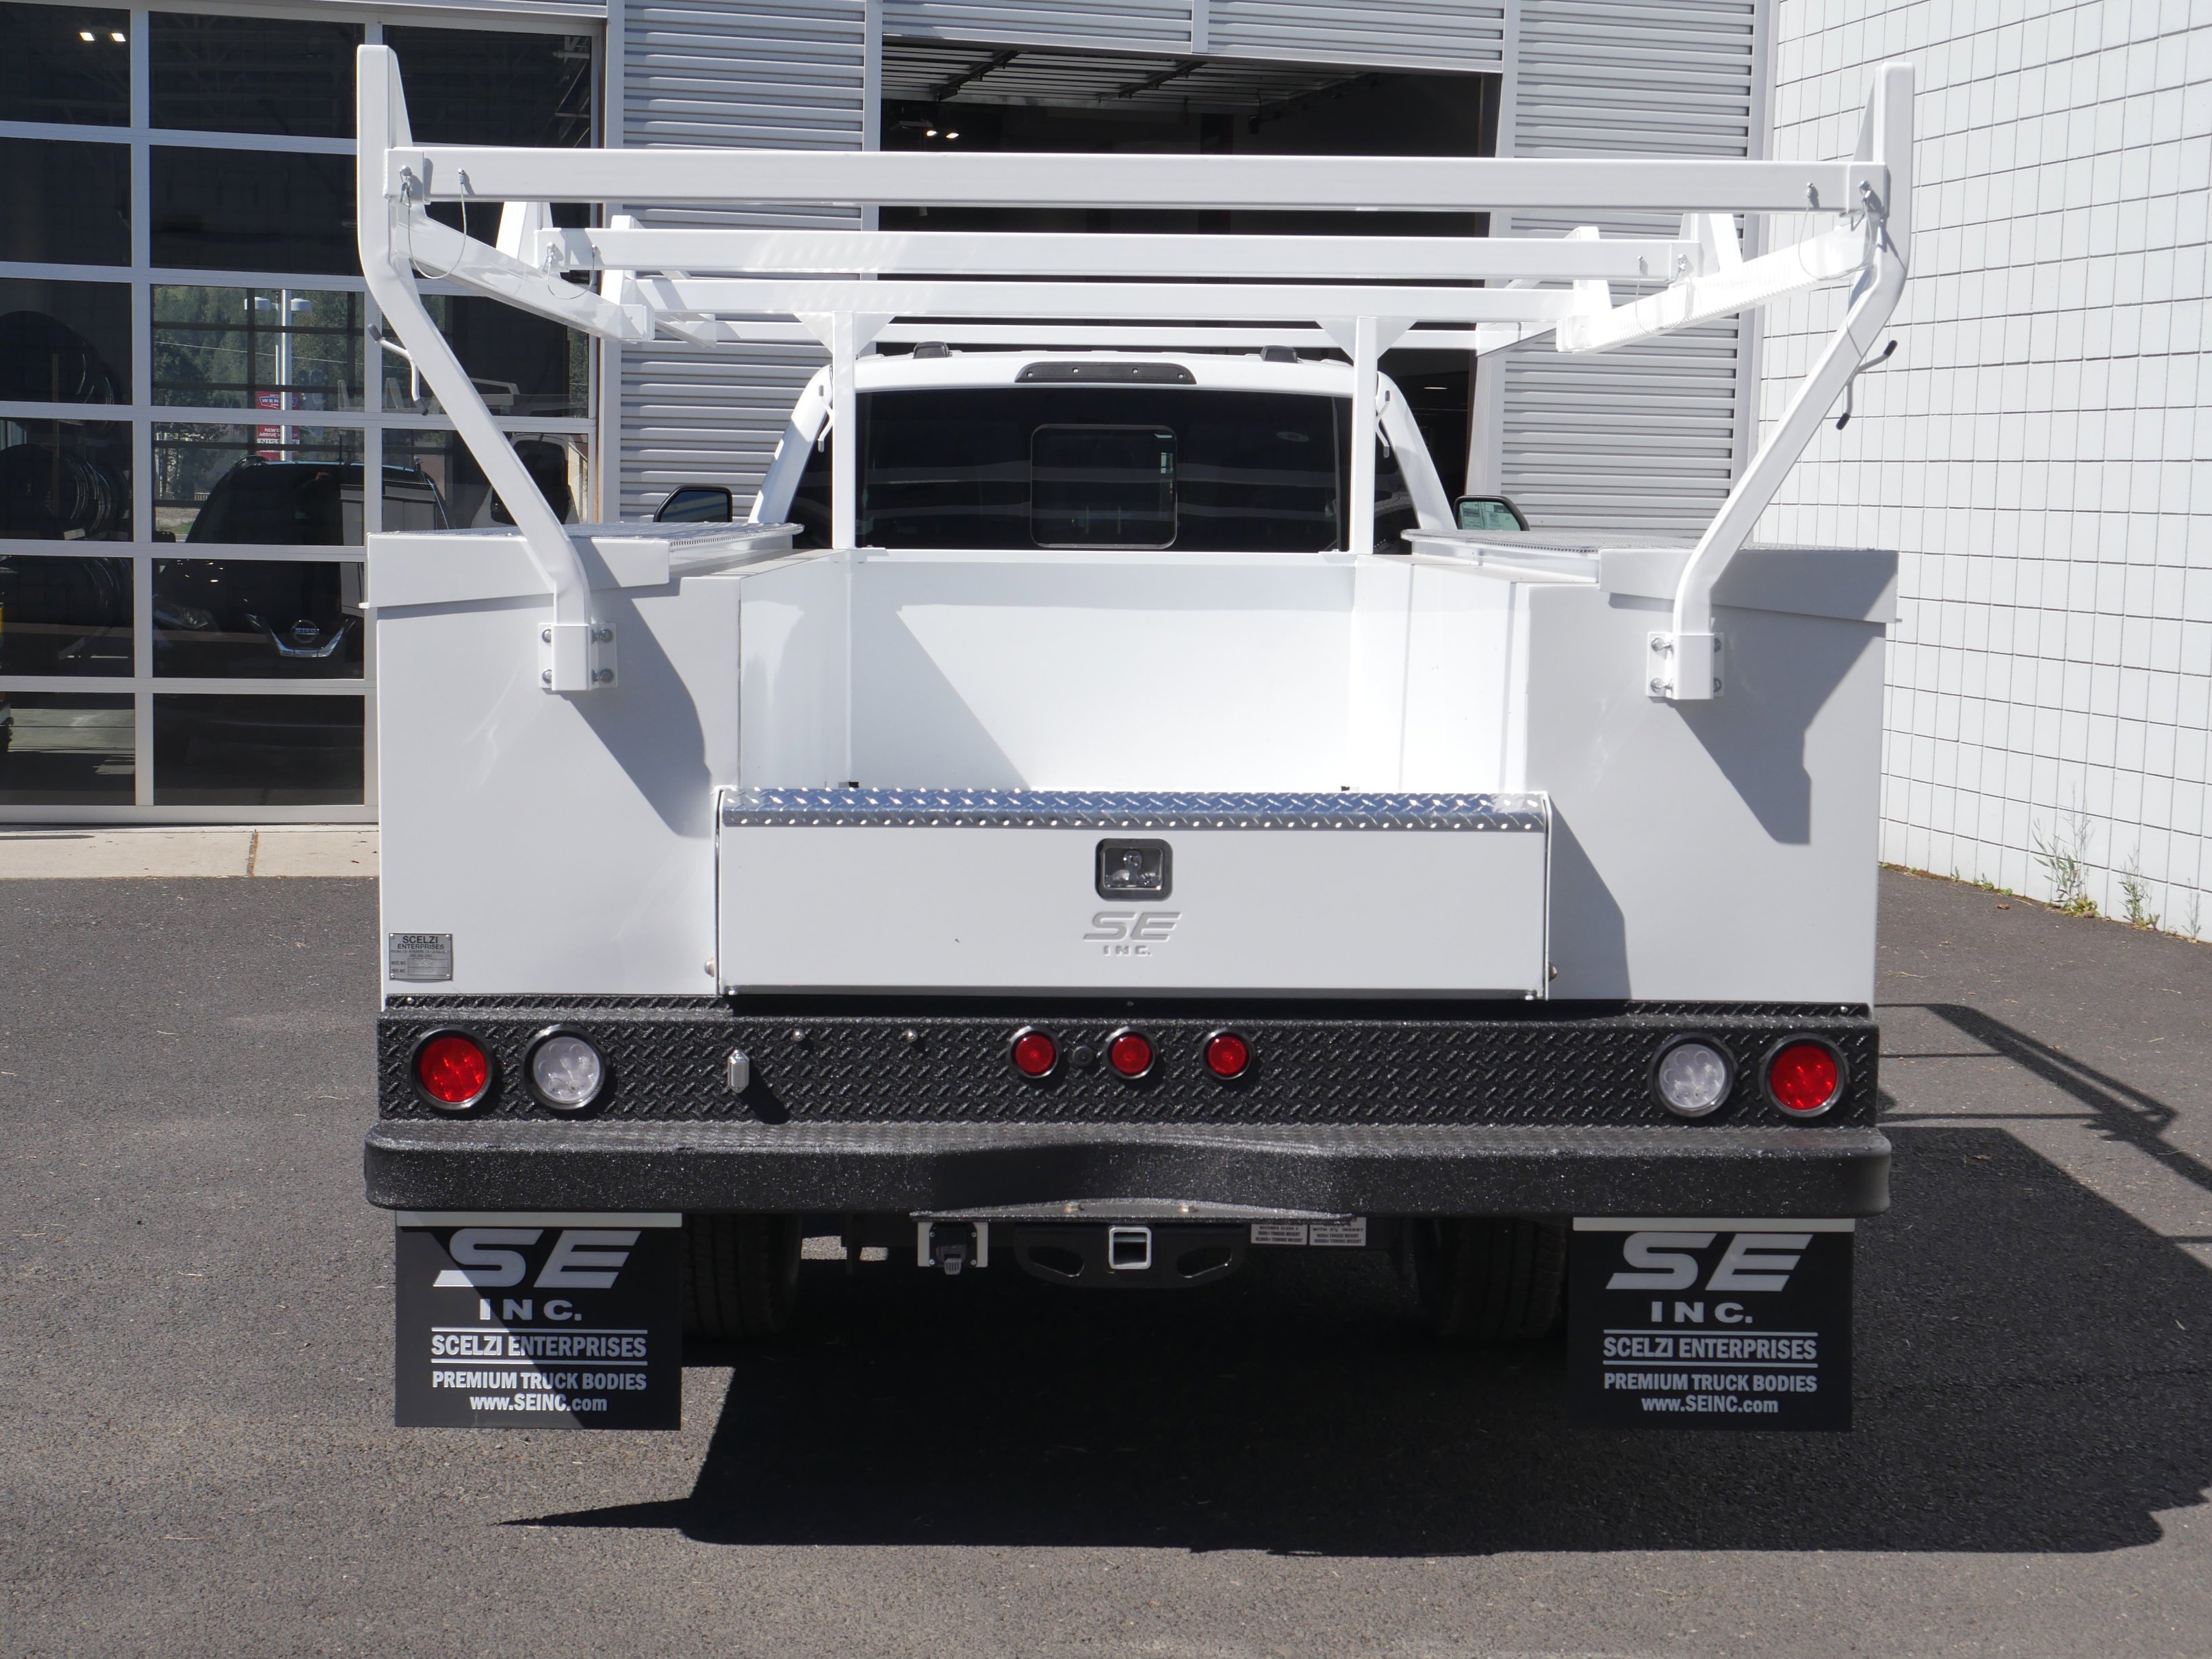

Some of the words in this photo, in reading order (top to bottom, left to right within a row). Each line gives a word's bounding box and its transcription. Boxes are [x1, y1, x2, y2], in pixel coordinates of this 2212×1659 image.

[1083, 912, 1182, 942] SE
[402, 936, 438, 944] SCELZI
[1103, 945, 1152, 957] INC.
[433, 1228, 641, 1289] SE
[1606, 1231, 1814, 1291] SE
[480, 1298, 582, 1321] INC.
[1651, 1301, 1753, 1324] INC.
[431, 1335, 502, 1356] SCELZI
[508, 1335, 647, 1357] ENTERPRISES
[1603, 1337, 1673, 1358] SCELZI
[1679, 1338, 1817, 1360] ENTERPRISES
[432, 1370, 517, 1389] PREMIUM
[520, 1372, 578, 1390] TRUCK
[582, 1373, 647, 1391] BODIES
[1604, 1372, 1688, 1390] PREMIUM
[1691, 1374, 1749, 1391] TRUCK
[1753, 1374, 1818, 1392] BODIES
[470, 1393, 608, 1411] www.SEINC.com
[1641, 1394, 1779, 1413] www.SEINC.com
